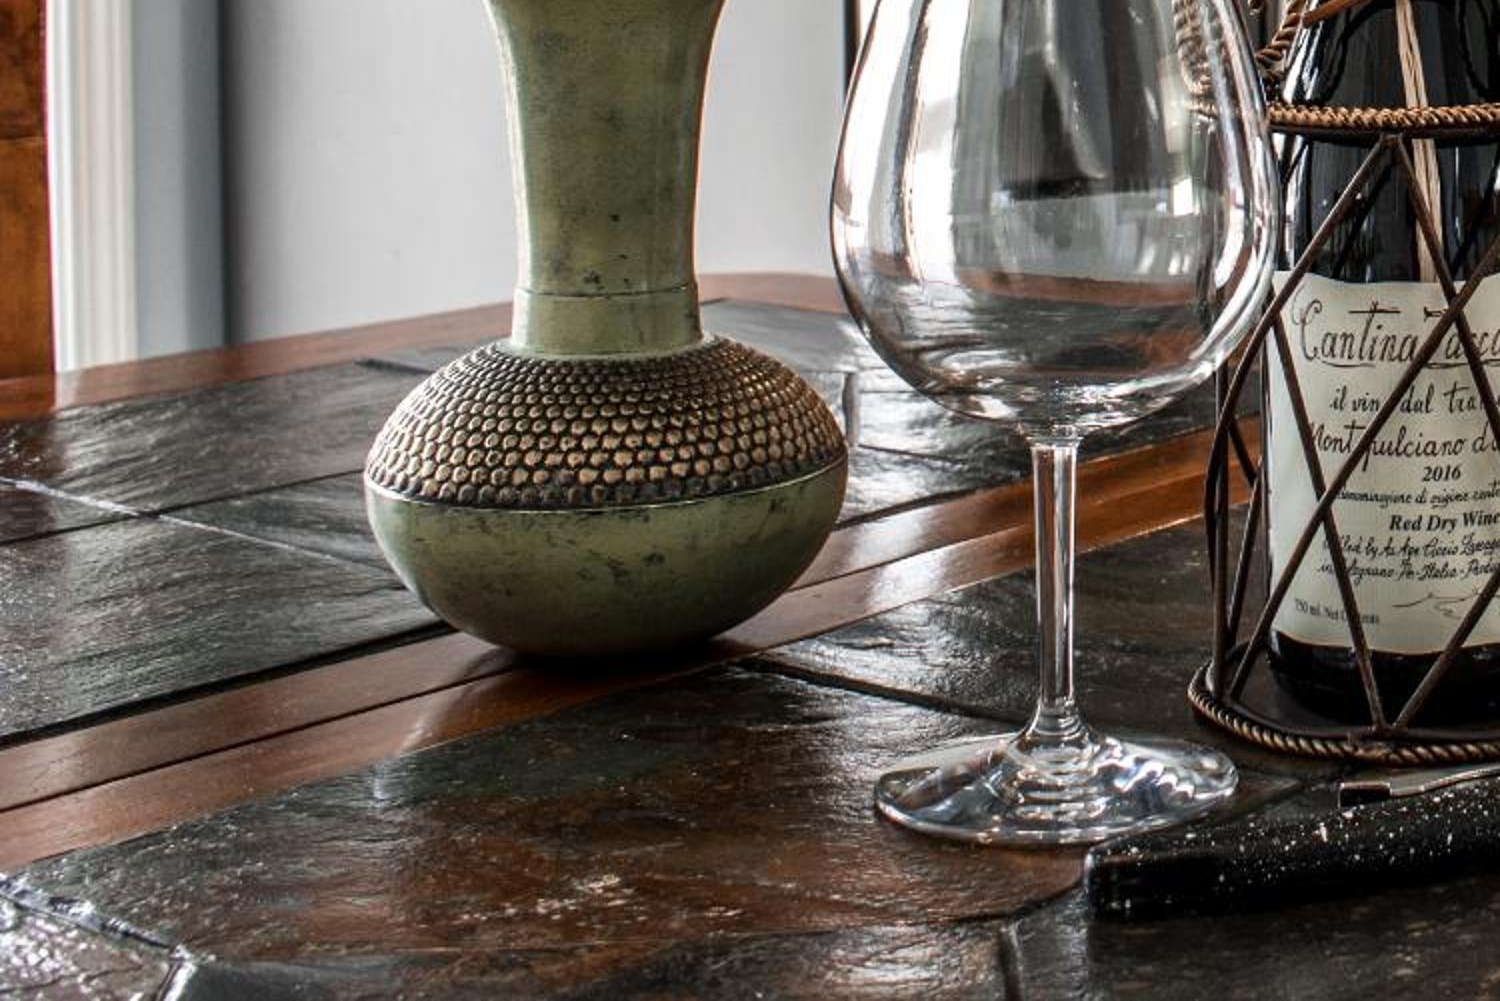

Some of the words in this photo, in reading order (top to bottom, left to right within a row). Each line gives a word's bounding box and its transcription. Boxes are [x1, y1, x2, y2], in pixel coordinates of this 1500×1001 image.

[1292, 300, 1418, 363] Cantina
[1351, 392, 1382, 412] vin
[1400, 382, 1434, 414] dal
[1311, 419, 1466, 472] Montpulciano
[1422, 466, 1462, 483] 2016
[1390, 514, 1422, 531] Red
[1426, 513, 1458, 534] Dry
[1462, 510, 1500, 527] Wine
